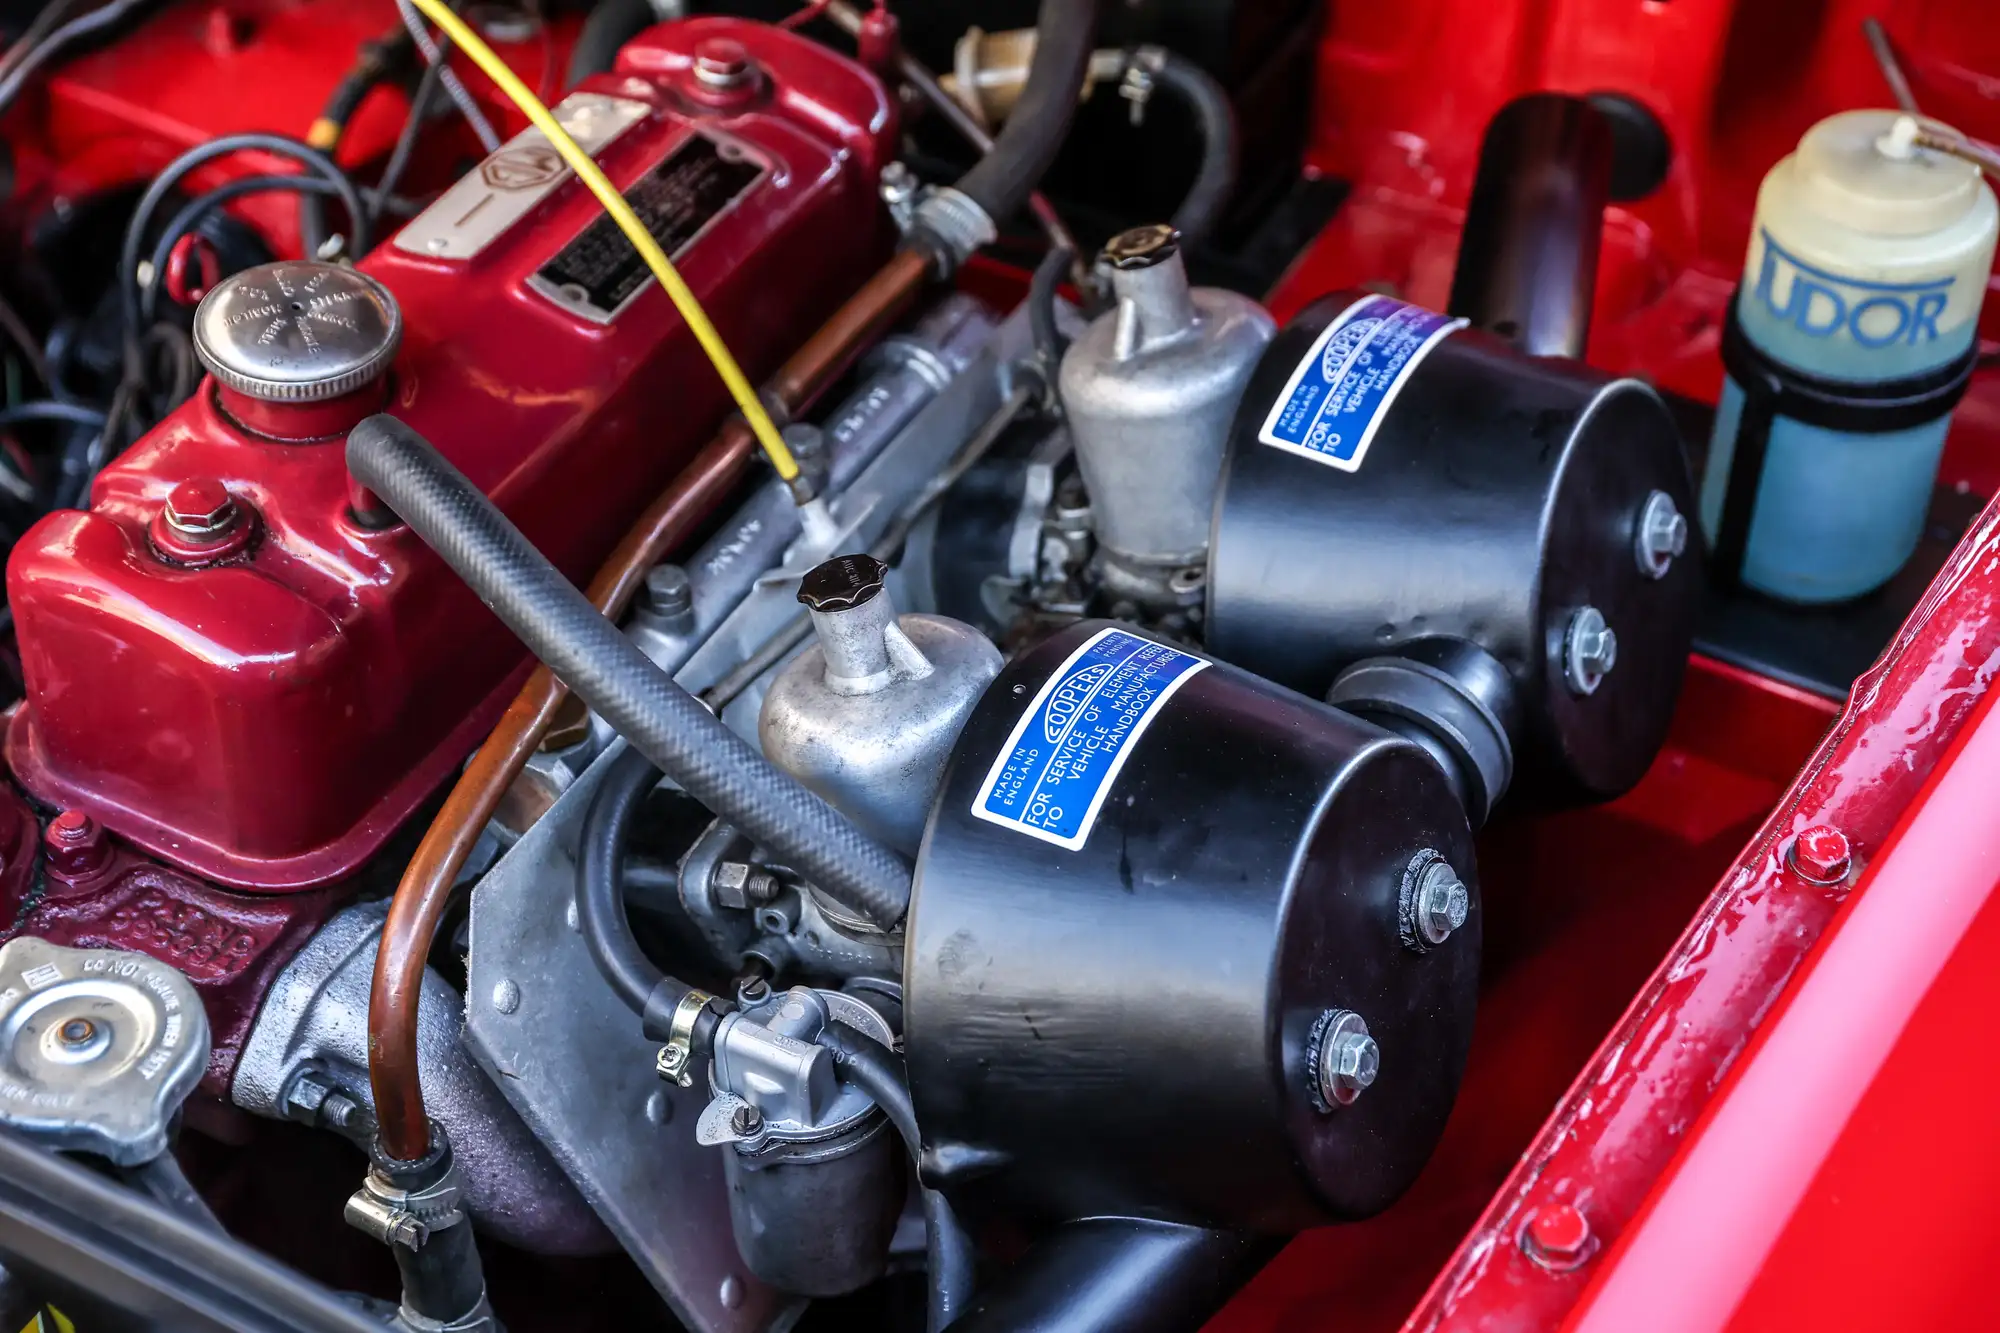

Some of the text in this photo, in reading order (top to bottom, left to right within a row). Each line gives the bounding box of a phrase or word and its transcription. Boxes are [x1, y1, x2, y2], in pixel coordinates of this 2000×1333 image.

[1755, 225, 1956, 349] TUDOR
[1373, 336, 1424, 391] HANDBOOK
[1279, 384, 1309, 428] MADE IN
[1288, 385, 1320, 434] ENGLAND
[1308, 421, 1333, 450] FOR
[1325, 370, 1361, 417] SERVICE
[1357, 349, 1375, 366] OF
[1322, 433, 1342, 453] TO
[1343, 366, 1381, 413] VEHICLE
[1093, 634, 1121, 654] PATENTS
[1103, 638, 1132, 658] PENDING
[1026, 645, 1167, 825] FOR SERVICE OF ELEMENT REFER
[1042, 650, 1181, 828] TO VEHICLE MANUFACTURERS
[1100, 687, 1157, 753] HANDBOOK
[993, 747, 1026, 798] MADE IN
[1003, 748, 1039, 806] ENGLAND
[108, 960, 144, 978] NOT
